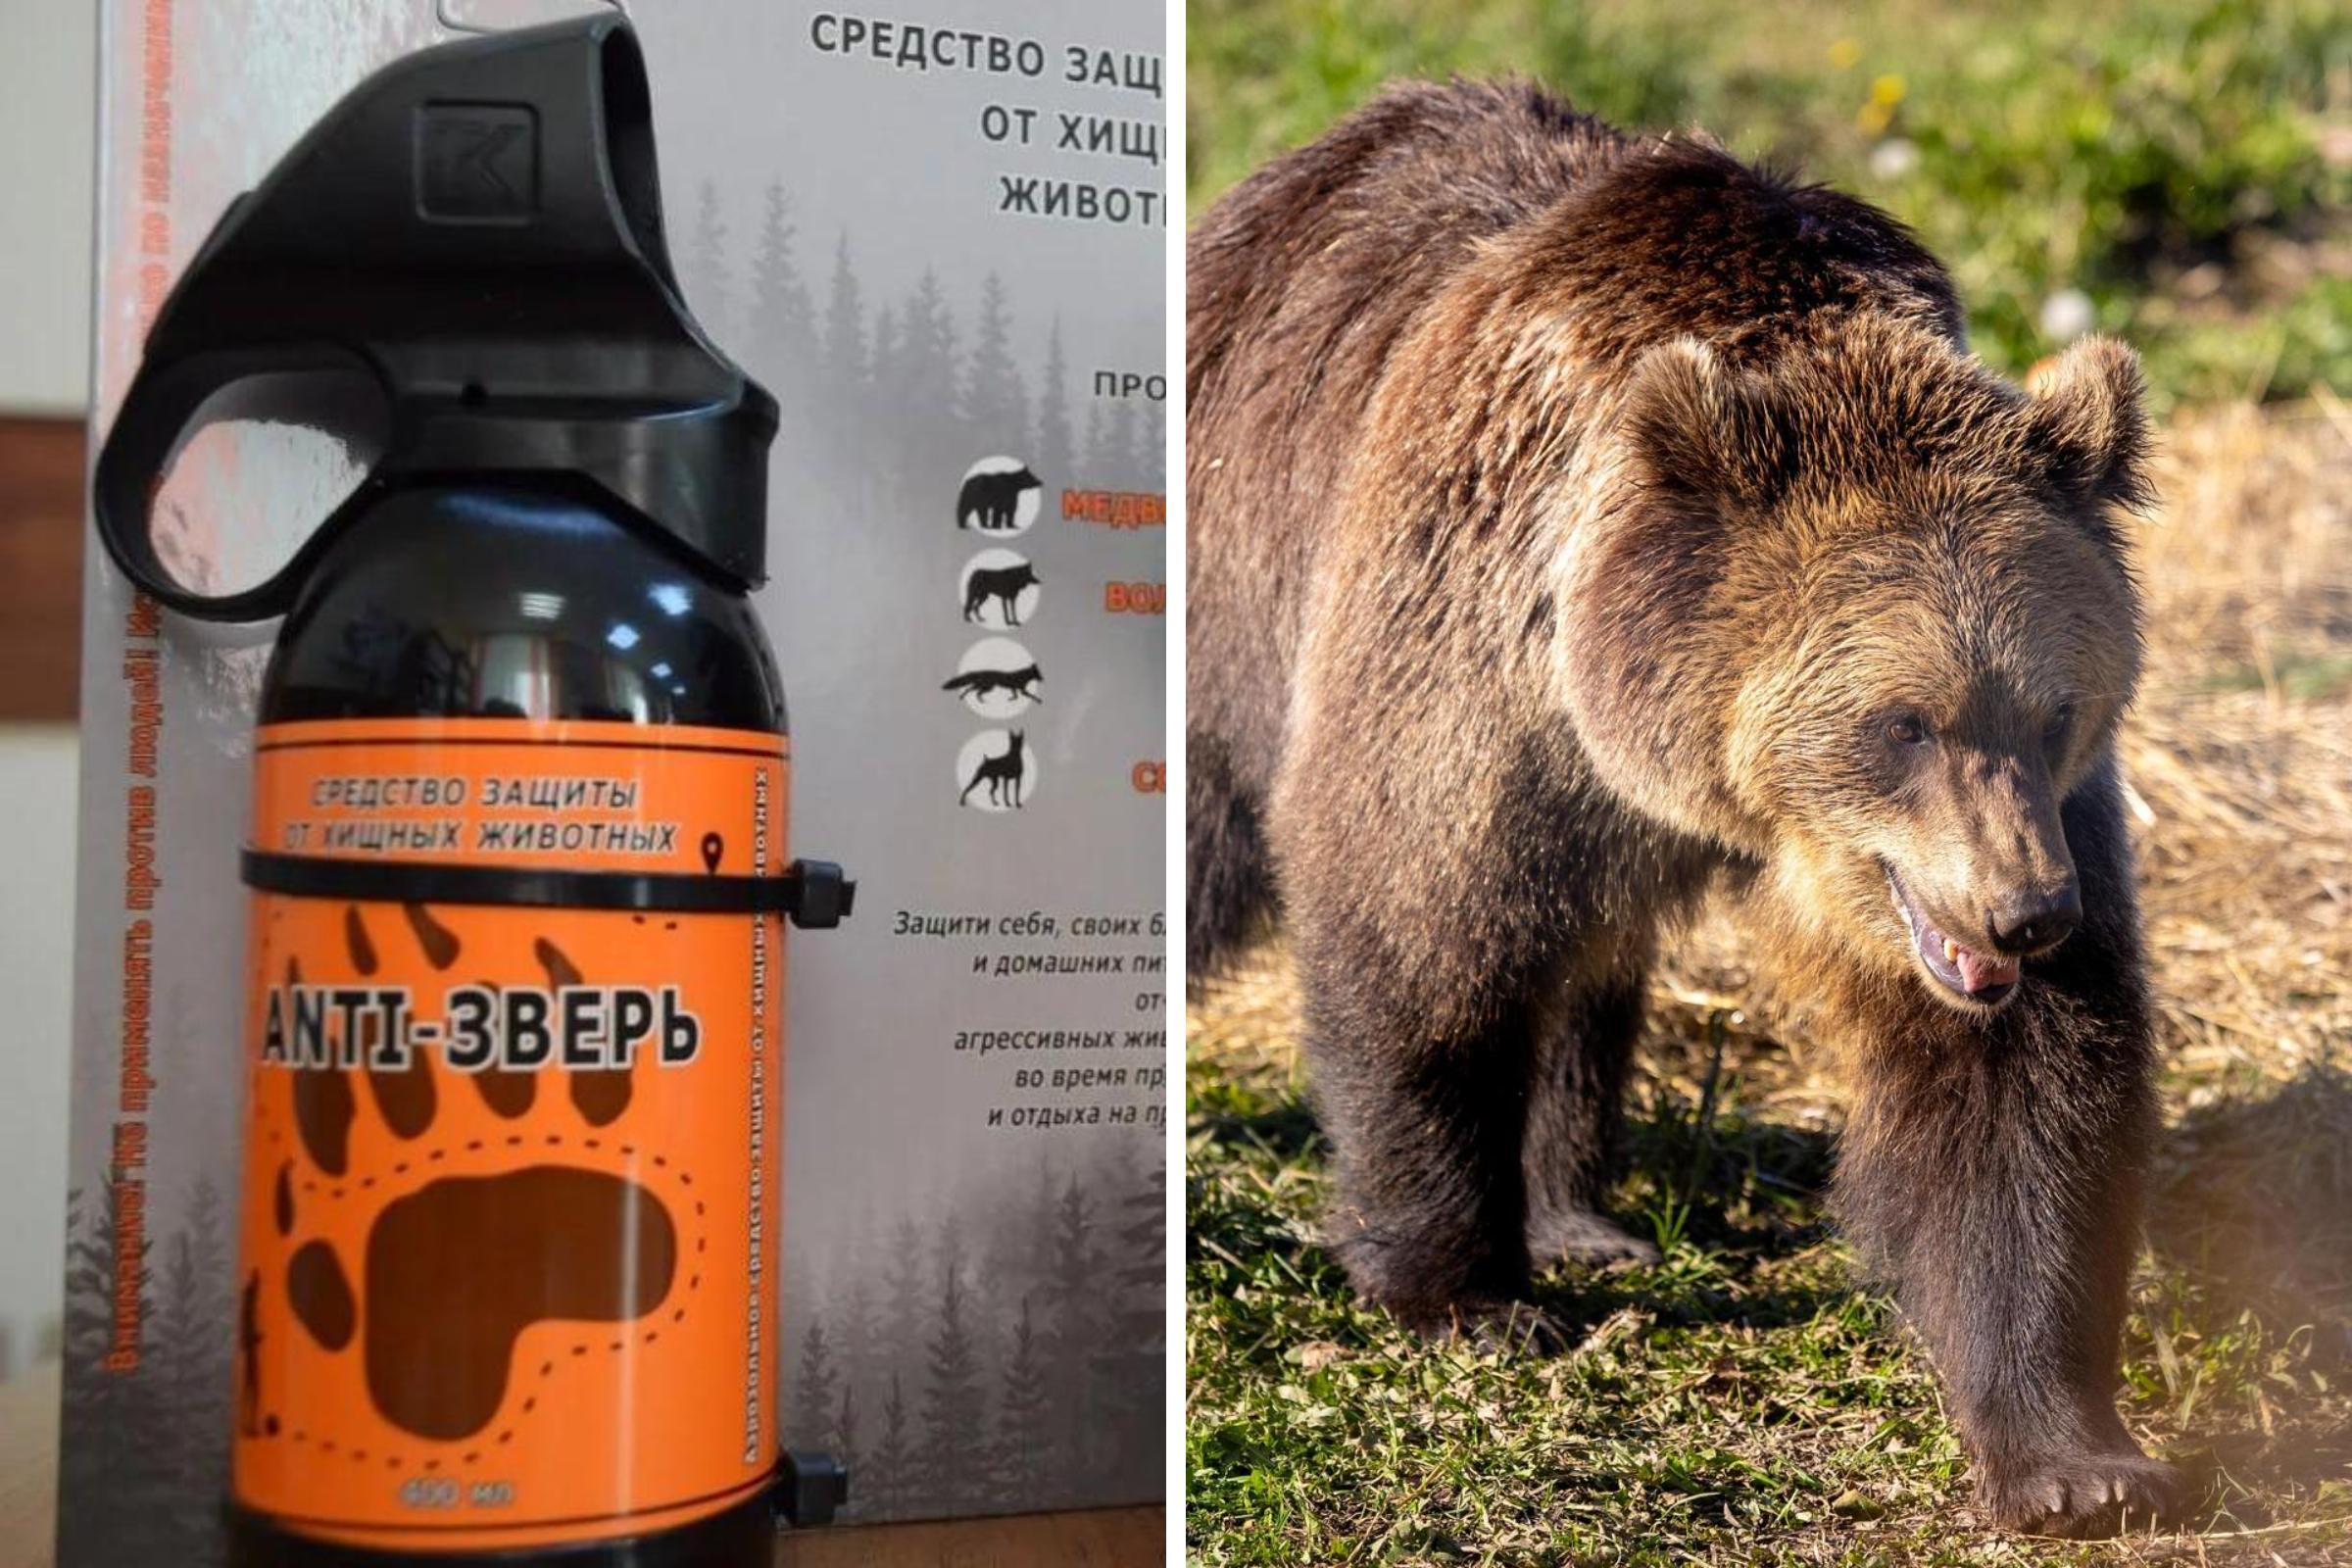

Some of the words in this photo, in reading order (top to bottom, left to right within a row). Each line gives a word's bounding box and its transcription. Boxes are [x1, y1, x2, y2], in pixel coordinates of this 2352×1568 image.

[810, 14, 1044, 76] СРЕДСТВО
[1065, 47, 1162, 98] ЗАЩ
[982, 105, 1037, 144] ОТ
[1058, 113, 1166, 166] ХИЩ
[1000, 175, 1166, 227] ЖИВОТ
[1095, 370, 1166, 401] ПРО
[123, 649, 164, 777] людей!
[311, 776, 466, 808] СРЕДСТВО
[480, 778, 637, 809] ЗАЩИТЫ
[321, 822, 462, 851] ХИЩНЫХ
[476, 821, 678, 853] ЖИВОТНЫХ
[752, 767, 769, 877] ивотных
[124, 785, 161, 910] против
[894, 910, 991, 938] Защити
[998, 911, 1059, 939] себя,
[1070, 917, 1141, 936] своих
[1150, 913, 1166, 936] б
[972, 955, 988, 973] и
[994, 955, 1123, 977] домашних
[119, 918, 155, 1112] применять
[1135, 992, 1166, 1012] от
[954, 1031, 1115, 1055] агрессивных
[1014, 1069, 1045, 1088] во
[1052, 1068, 1127, 1092] время
[749, 1059, 764, 1160] защиты
[988, 1108, 1004, 1126] и
[1010, 1105, 1101, 1129] отдыха
[1107, 1105, 1137, 1125] на
